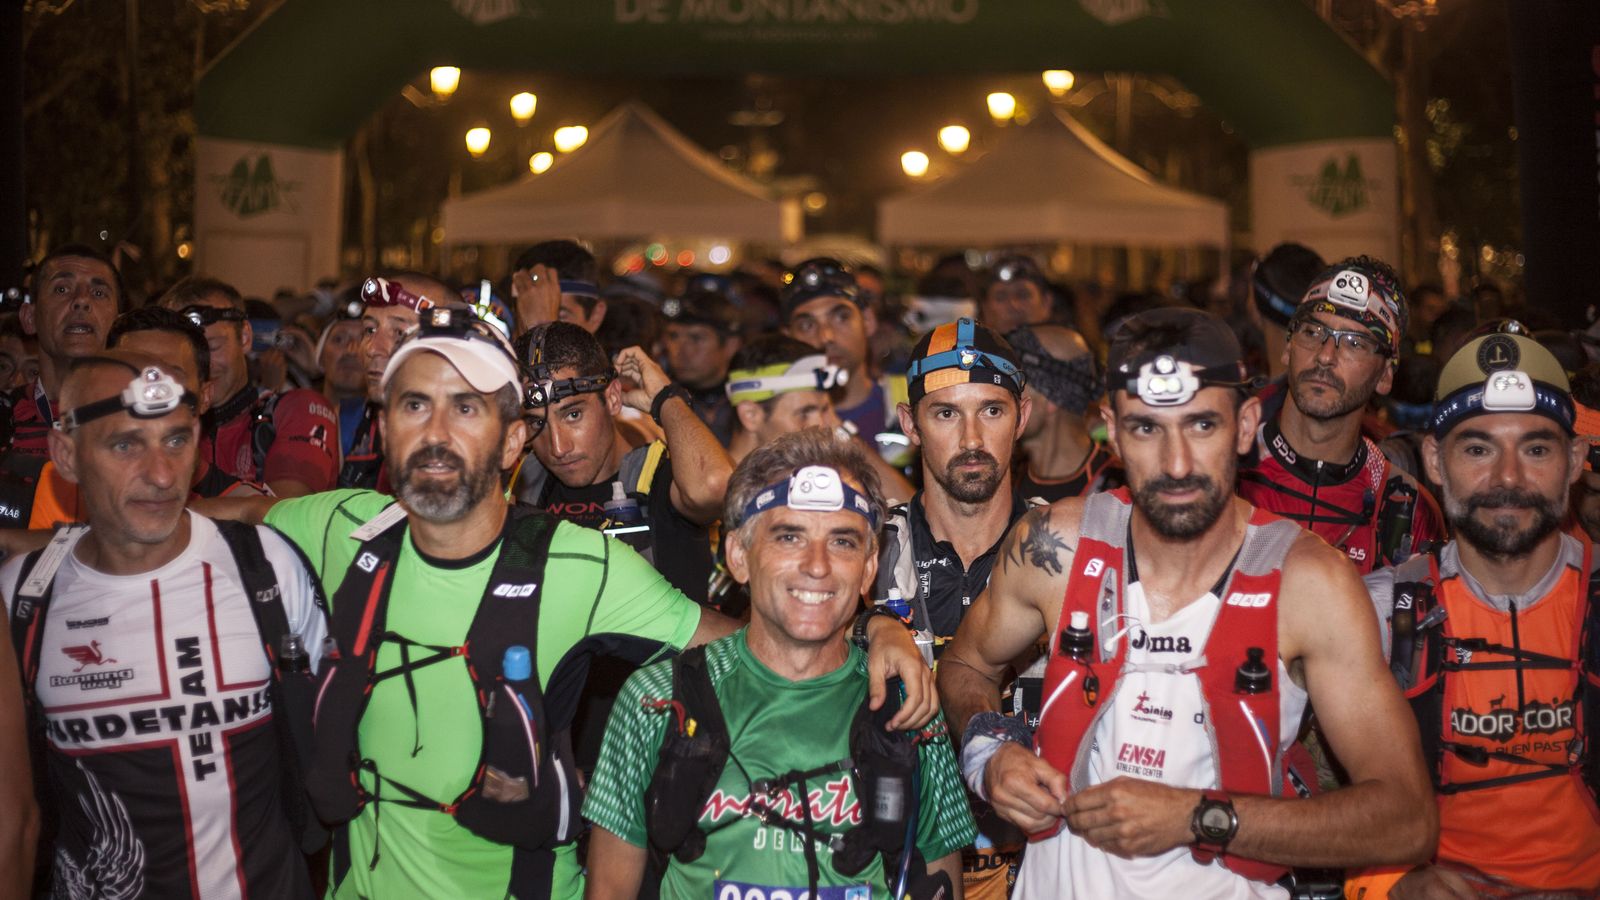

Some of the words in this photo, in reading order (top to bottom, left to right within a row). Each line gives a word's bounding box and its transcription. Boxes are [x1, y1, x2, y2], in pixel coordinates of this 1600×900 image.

[614, 0, 668, 24] DE
[49, 668, 134, 688] Running
[174, 635, 217, 782] TEAM
[1117, 742, 1167, 769] ENSA
[1116, 762, 1141, 775] ATHLETIC
[1142, 767, 1163, 779] CENTER
